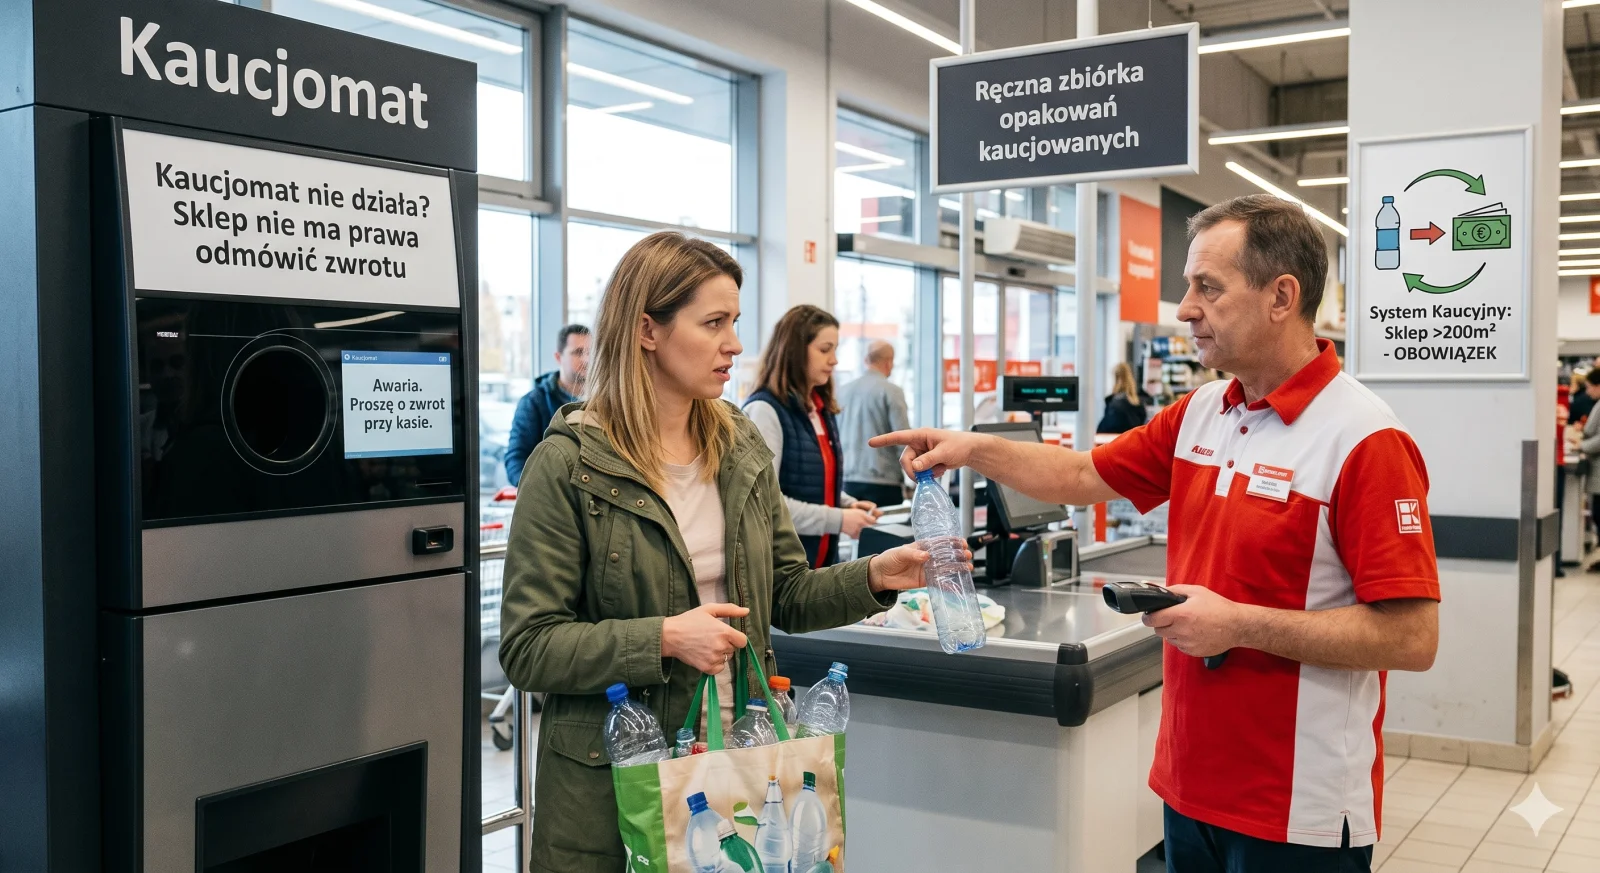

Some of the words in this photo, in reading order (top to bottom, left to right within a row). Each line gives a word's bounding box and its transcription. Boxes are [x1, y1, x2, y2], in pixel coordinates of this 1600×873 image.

[120, 16, 429, 129] Kaucjomat
[975, 77, 1052, 104] Ręczna
[1059, 62, 1143, 91] zbiórka
[999, 95, 1118, 132] opakowań
[979, 126, 1140, 161] kaucjowanych
[156, 162, 300, 203] Kaucjomat
[308, 183, 343, 207] nie
[352, 188, 429, 217] działa?
[173, 200, 248, 235] Sklep
[257, 211, 294, 236] nie
[304, 221, 340, 240] ma
[349, 225, 418, 248] prawa
[196, 240, 317, 271] odmówić
[325, 256, 405, 278] zwrotu
[1370, 306, 1426, 322] System
[1433, 303, 1511, 320] Kaucyjny:
[1385, 326, 1428, 342] Sklep
[1433, 323, 1496, 338] >200m²
[1394, 346, 1497, 363] OBOWIĄZEK
[373, 379, 422, 392] Awaria.
[351, 398, 393, 413] Proszę
[397, 400, 406, 411] o
[410, 398, 445, 410] zwrot
[365, 420, 392, 433] przy
[397, 416, 432, 428] kasie.
